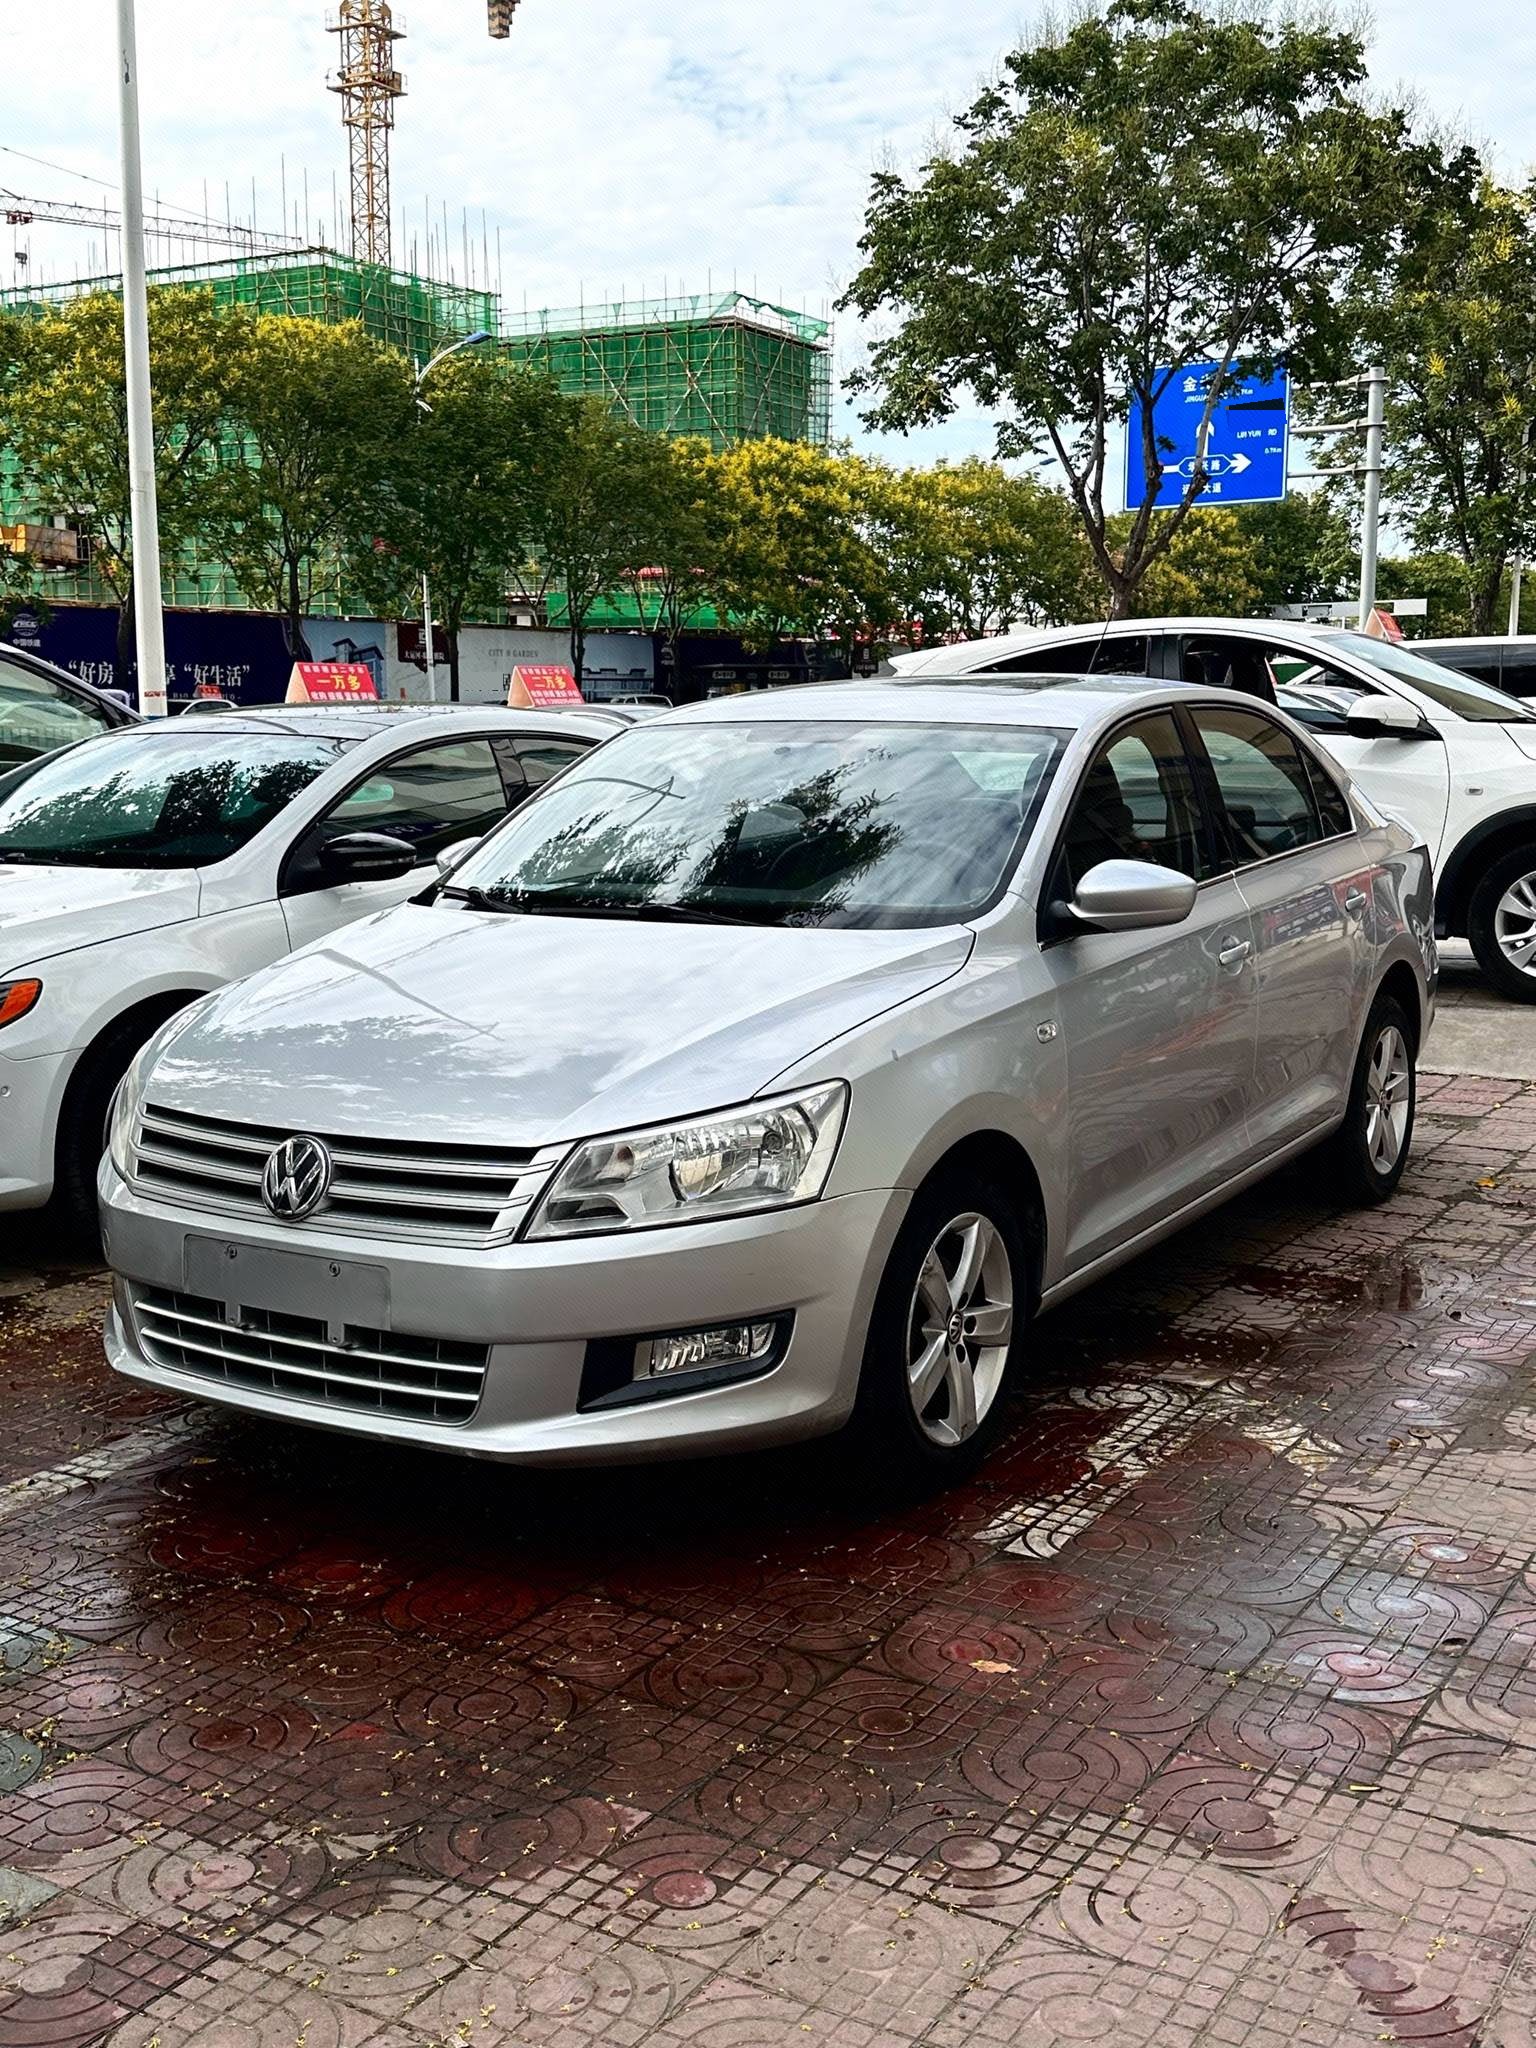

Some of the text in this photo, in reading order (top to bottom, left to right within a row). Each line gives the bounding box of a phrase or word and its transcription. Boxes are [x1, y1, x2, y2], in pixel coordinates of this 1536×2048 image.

[317, 675, 361, 691] 一万多
[531, 675, 567, 690] 二万多
